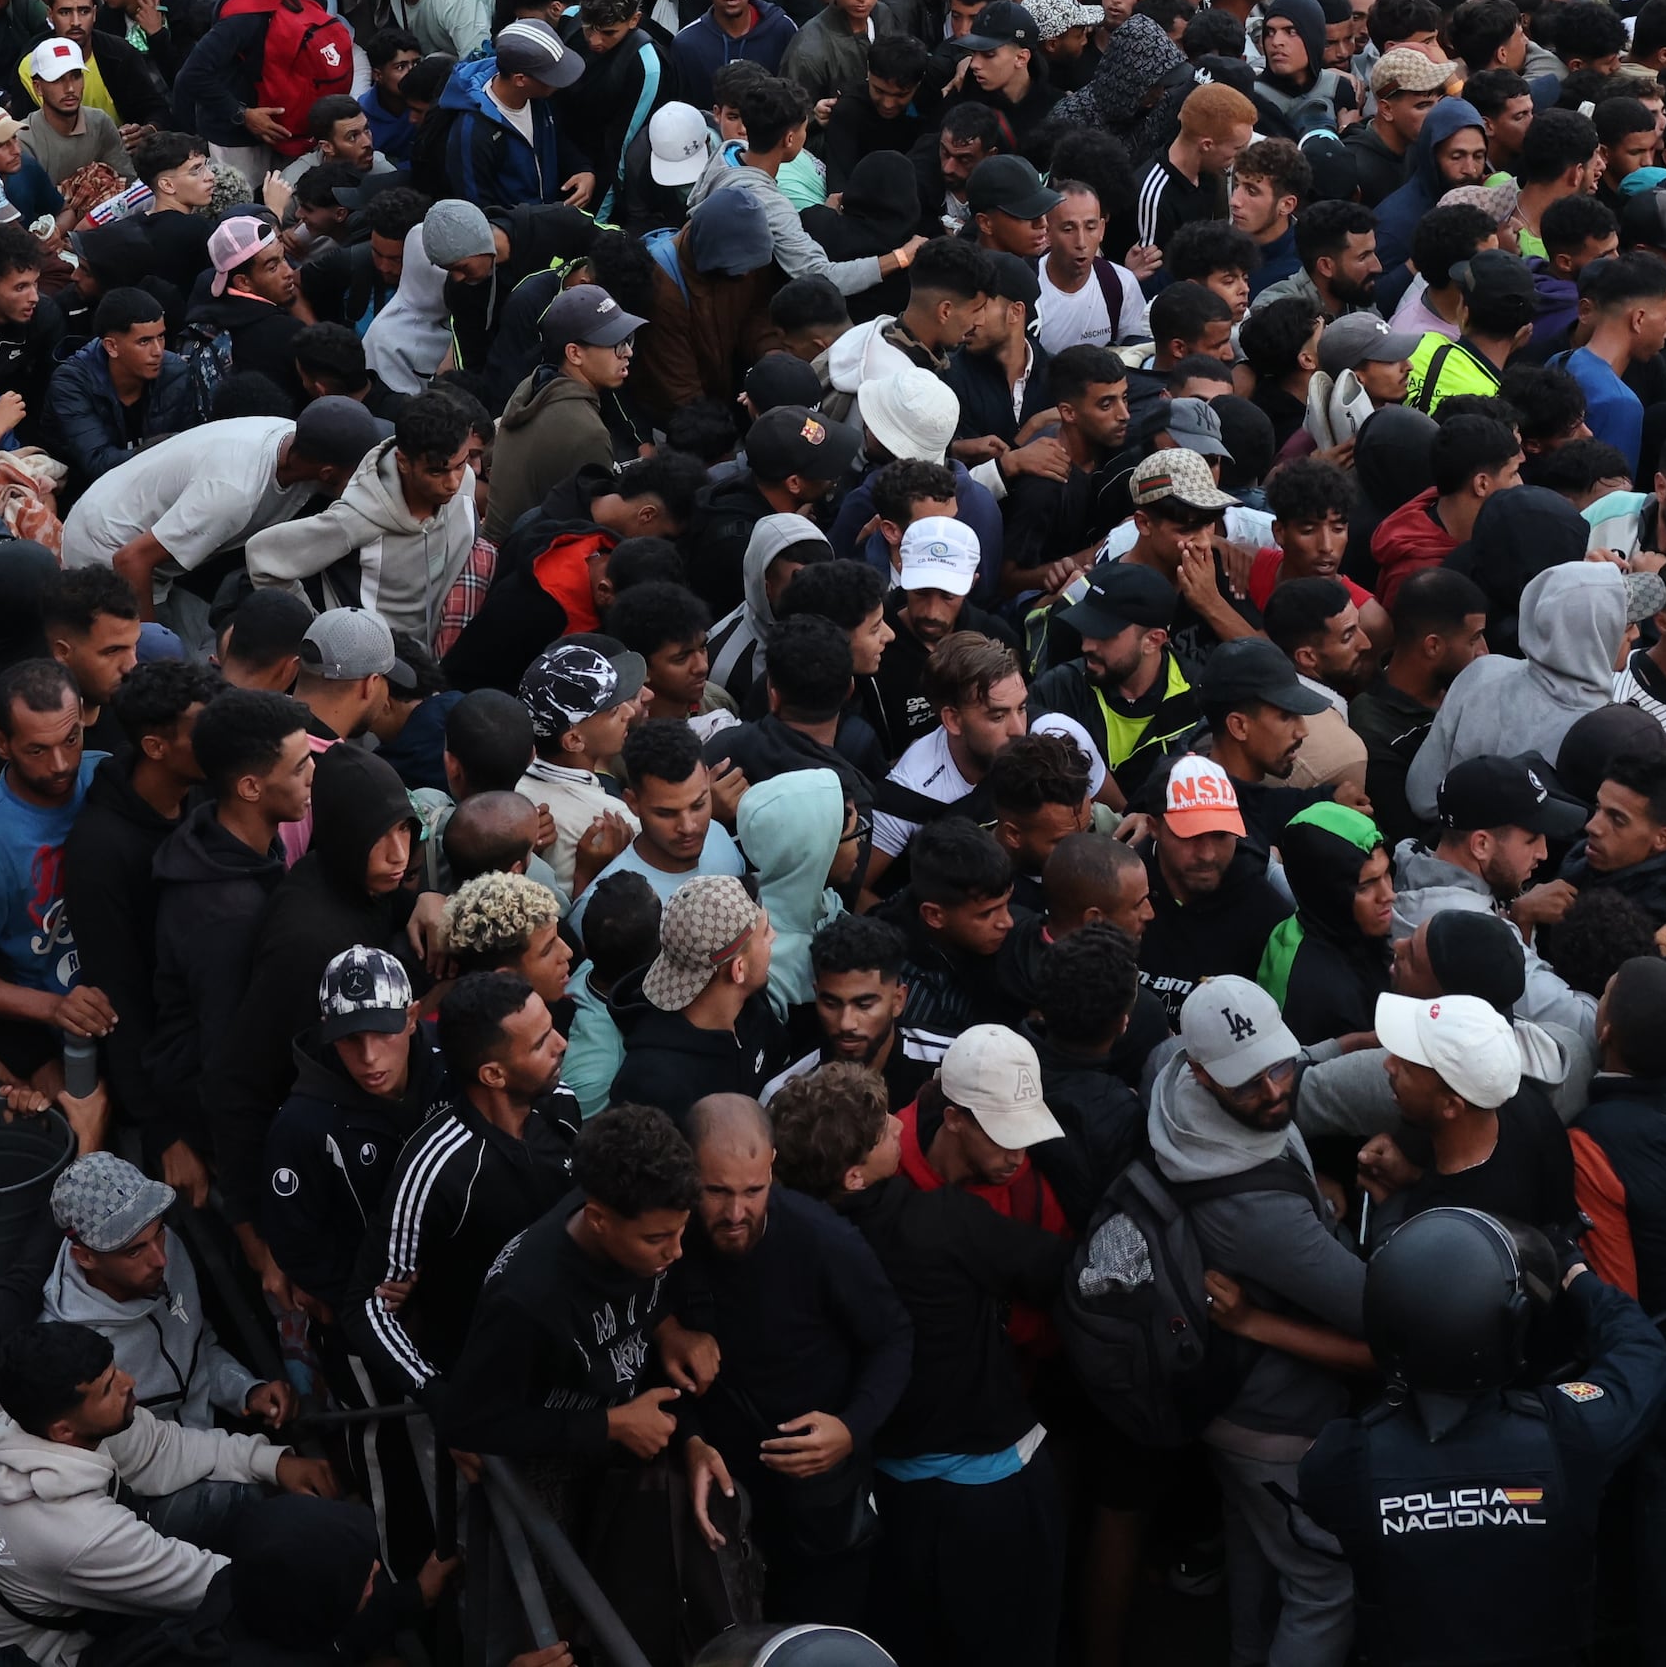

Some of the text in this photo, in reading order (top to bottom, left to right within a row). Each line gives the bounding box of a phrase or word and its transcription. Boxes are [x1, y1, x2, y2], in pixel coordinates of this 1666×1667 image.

[1221, 1007, 1257, 1042] LA
[1379, 1487, 1510, 1516] POLICIA
[1382, 1508, 1548, 1535] NACIONAL
